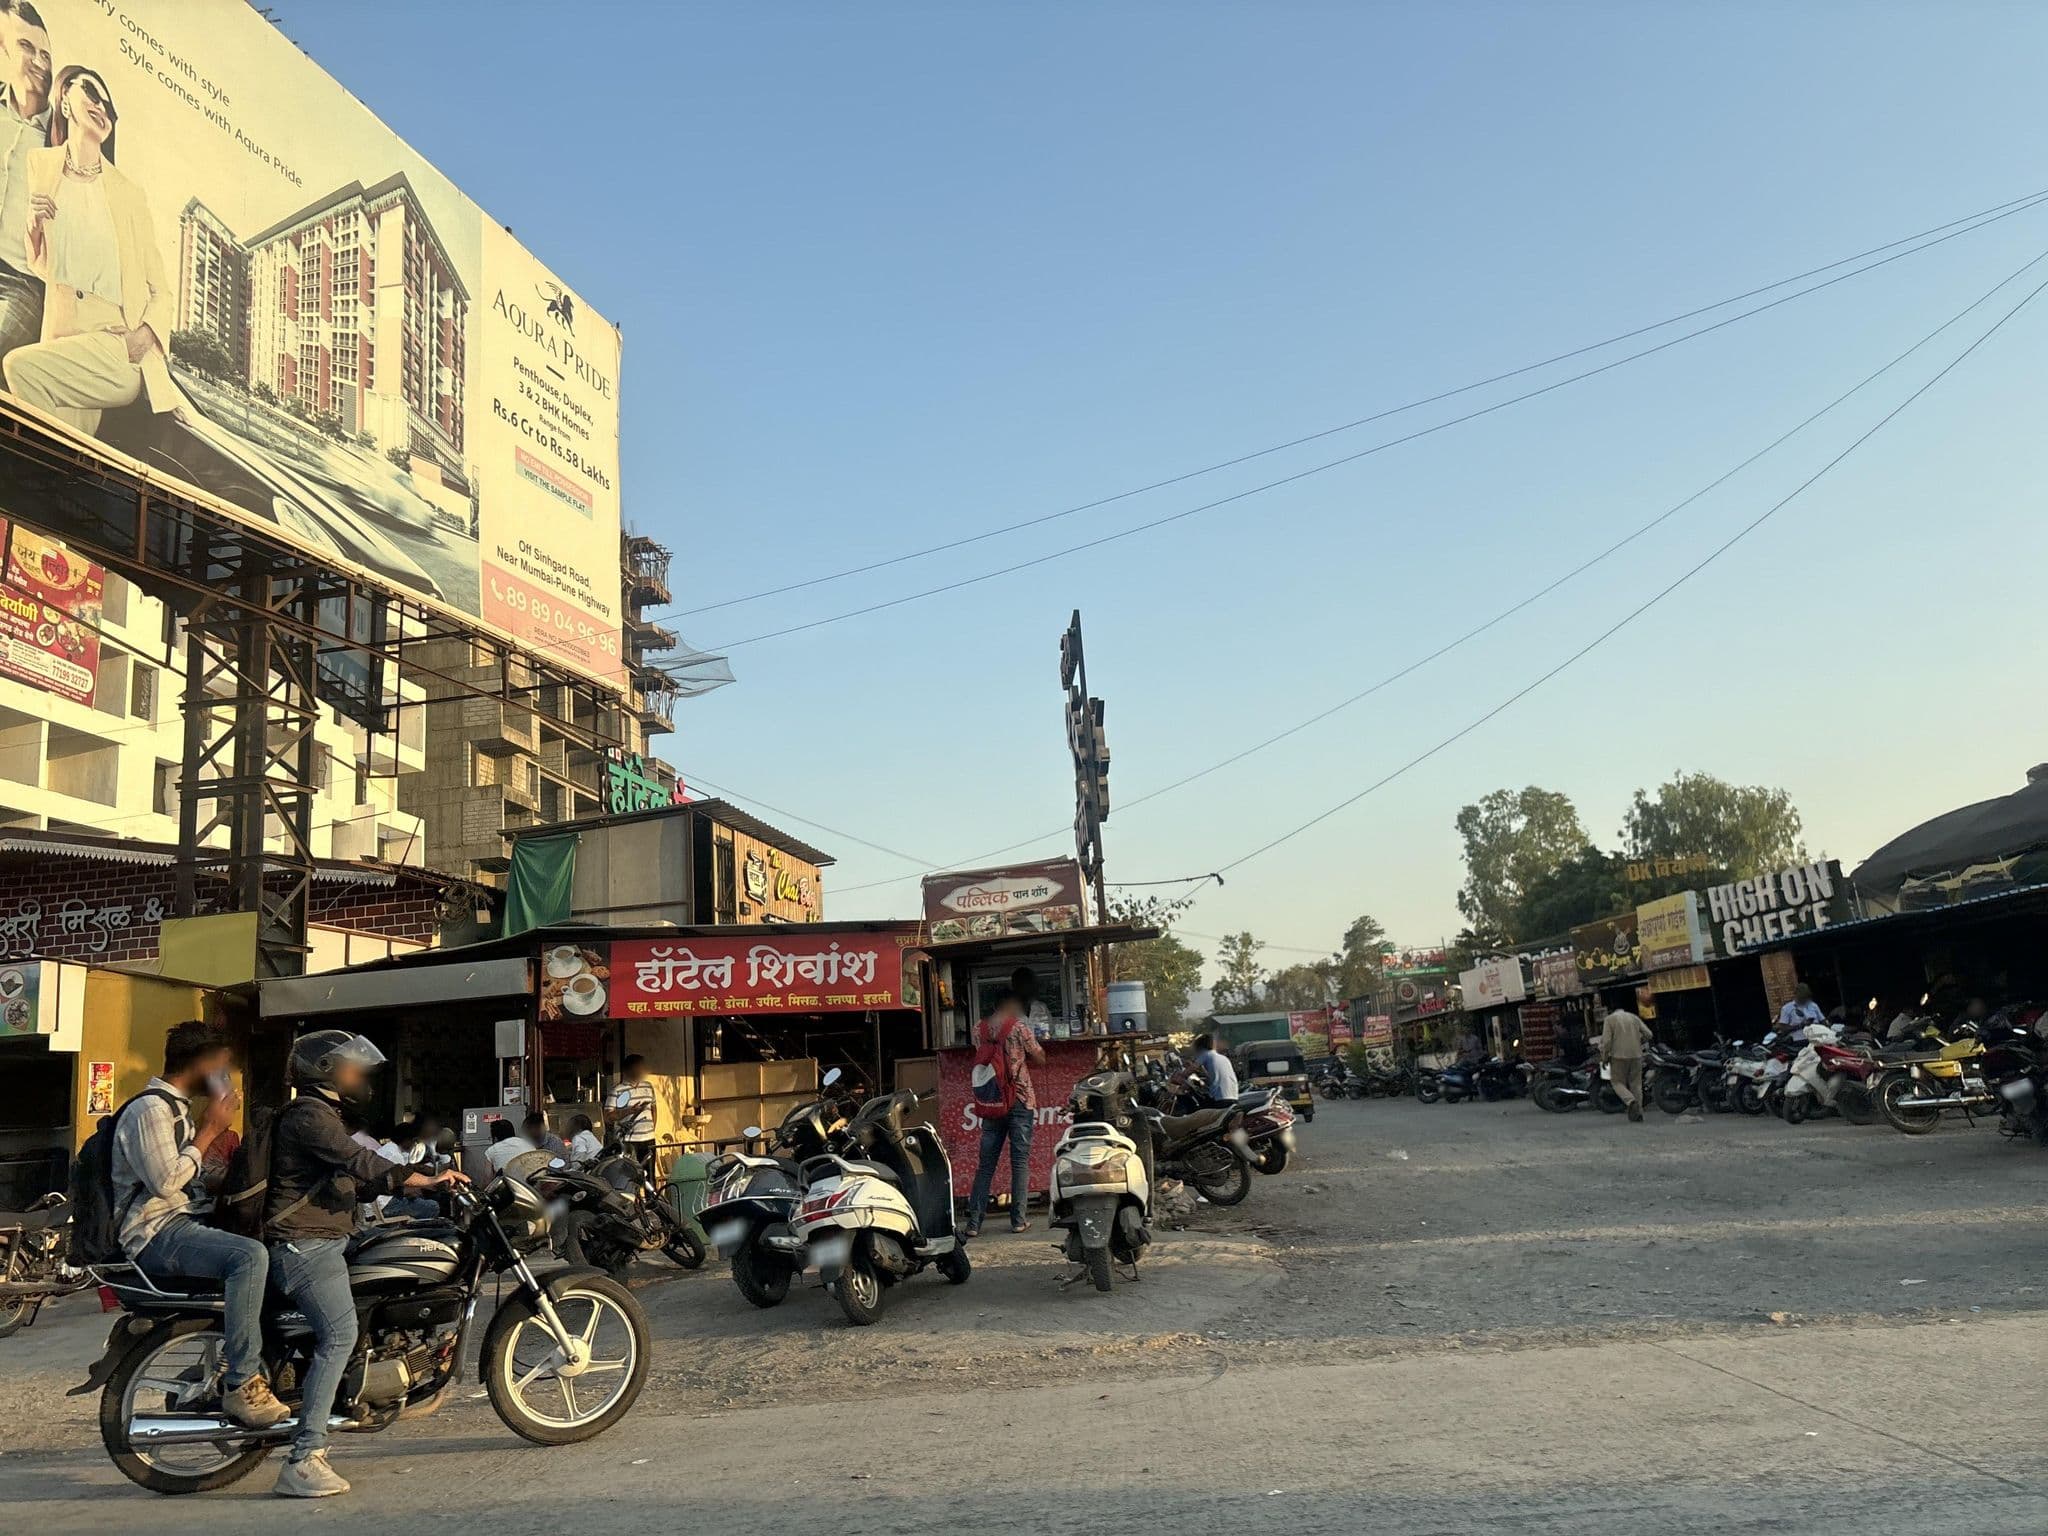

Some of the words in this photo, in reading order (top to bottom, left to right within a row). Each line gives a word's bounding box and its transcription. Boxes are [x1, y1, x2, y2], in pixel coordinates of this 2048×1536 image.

[119, 14, 164, 55] comes
[168, 51, 198, 81] with
[201, 78, 230, 106] style
[119, 38, 154, 73] Style
[157, 71, 200, 110] comes
[203, 105, 231, 133] with
[235, 128, 270, 163] Aqura
[273, 156, 303, 188] Pride
[513, 355, 561, 402] Penthouse,
[563, 393, 594, 427] Duplex,
[519, 381, 525, 394] 3
[526, 387, 534, 400] &
[535, 393, 541, 406] 2
[542, 397, 560, 420] BHK
[561, 411, 590, 440] Homes
[493, 397, 519, 428] Rs.6
[521, 418, 534, 437] Cr
[535, 428, 548, 447] to
[550, 437, 579, 468] Rs.58
[581, 458, 610, 490] Lakhs
[539, 414, 557, 432] Range
[557, 425, 571, 441] from
[523, 468, 539, 482] VISIT
[539, 477, 550, 490] THE
[550, 485, 572, 505] SAMPLE
[572, 499, 586, 512] FLAT
[497, 545, 518, 566] Near
[520, 559, 576, 597] Mumbai-Pune
[578, 588, 611, 617] Highway
[518, 540, 532, 556] Off
[534, 548, 567, 576] Sinhgad
[569, 566, 592, 590] Road,
[506, 586, 527, 612] 89
[531, 598, 550, 623] 89
[554, 609, 574, 636] 04
[577, 621, 596, 646] 96
[599, 633, 617, 657] 96
[957, 887, 1010, 908] पब्लिक
[1013, 889, 1029, 899] पान
[1031, 884, 1048, 898] शॉप
[1708, 871, 1777, 923] HIGH
[1780, 860, 1834, 906] ON
[59, 899, 132, 951] मिसळ
[144, 897, 165, 921] &
[634, 947, 735, 993] हॉटेल
[746, 942, 878, 988] शिवांश
